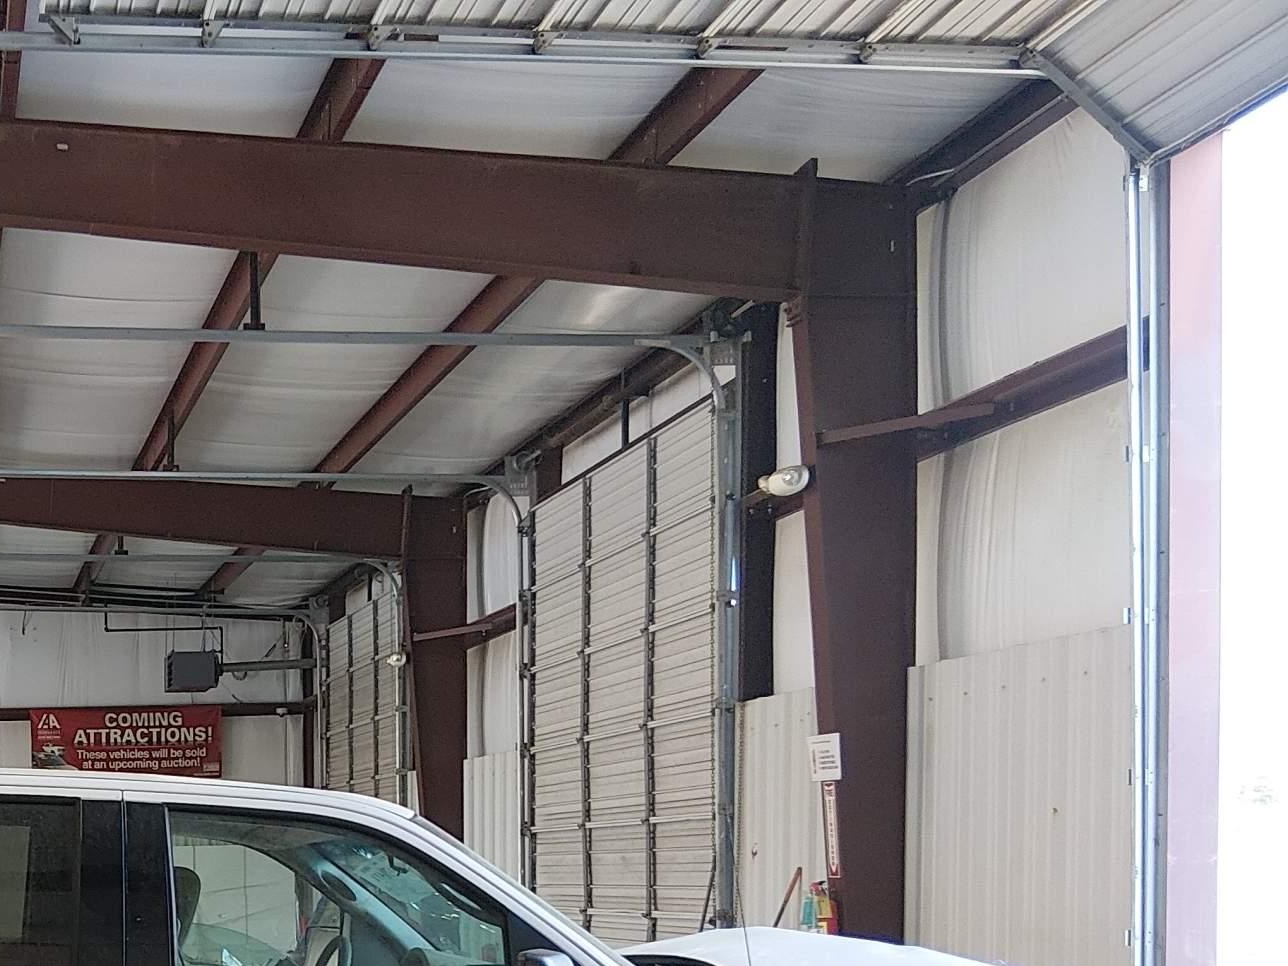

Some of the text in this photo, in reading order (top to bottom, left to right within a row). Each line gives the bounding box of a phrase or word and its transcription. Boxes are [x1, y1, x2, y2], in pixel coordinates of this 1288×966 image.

[104, 711, 183, 727] COMING
[73, 726, 212, 744] ATTRACTIONS!
[77, 747, 207, 760] These vehicles will be sold
[82, 760, 92, 769] at
[93, 761, 107, 769] an
[108, 758, 159, 771] upcoming
[160, 757, 201, 768] auction!
